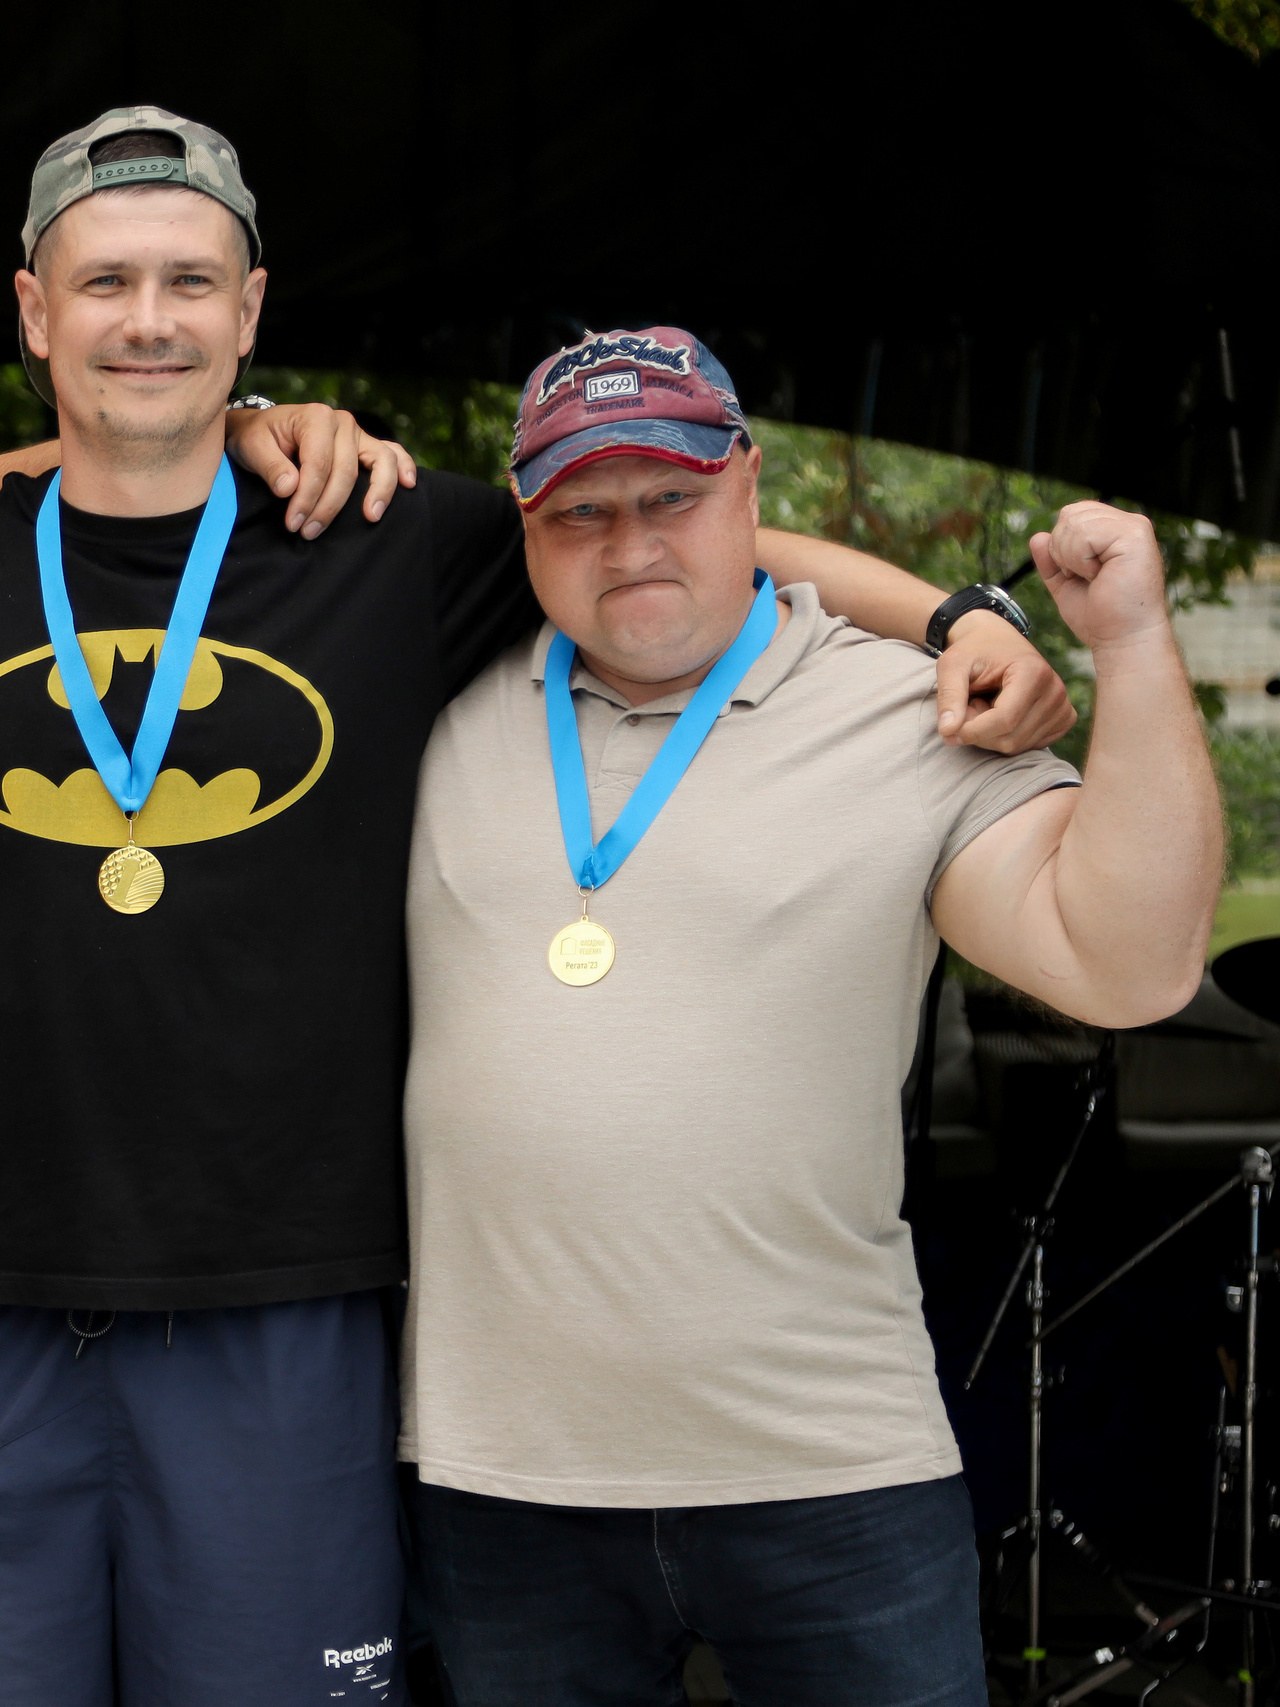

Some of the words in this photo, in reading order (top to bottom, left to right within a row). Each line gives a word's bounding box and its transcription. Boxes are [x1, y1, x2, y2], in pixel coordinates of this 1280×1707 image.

[591, 376, 632, 396] 1969
[536, 388, 584, 426] KINGSTON
[642, 377, 694, 400] JAMAICA
[584, 397, 645, 415] TRADEMARK
[324, 1637, 393, 1669] Reebok
